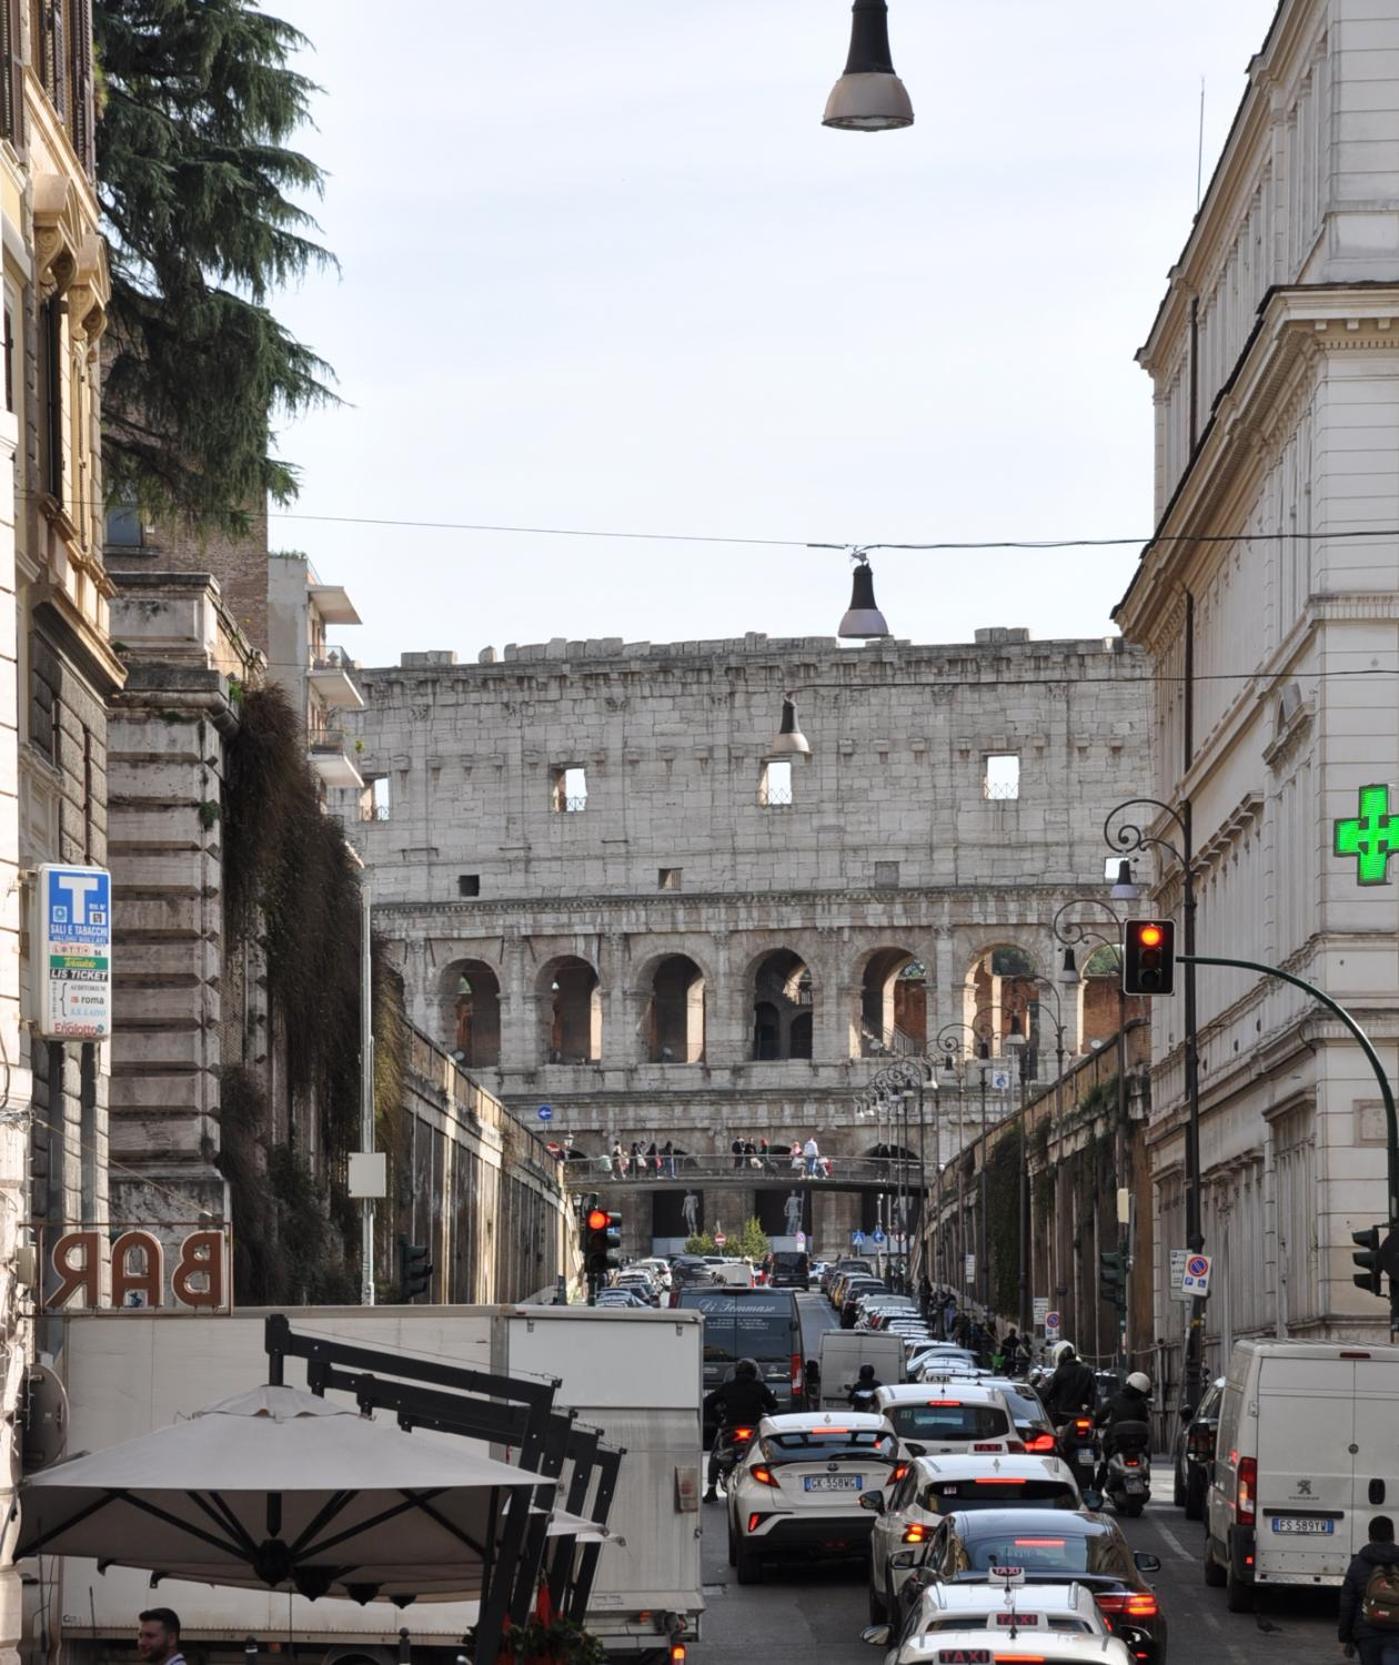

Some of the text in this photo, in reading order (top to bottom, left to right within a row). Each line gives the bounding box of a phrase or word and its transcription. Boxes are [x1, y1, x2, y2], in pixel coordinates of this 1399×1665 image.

[59, 876, 98, 924] T
[51, 924, 107, 937] SALI E TABACCHI
[51, 969, 107, 980] LIS TICKET
[81, 996, 104, 1005] roma
[1000, 1614, 1036, 1624] TAXI
[943, 1651, 988, 1662] TAXI
